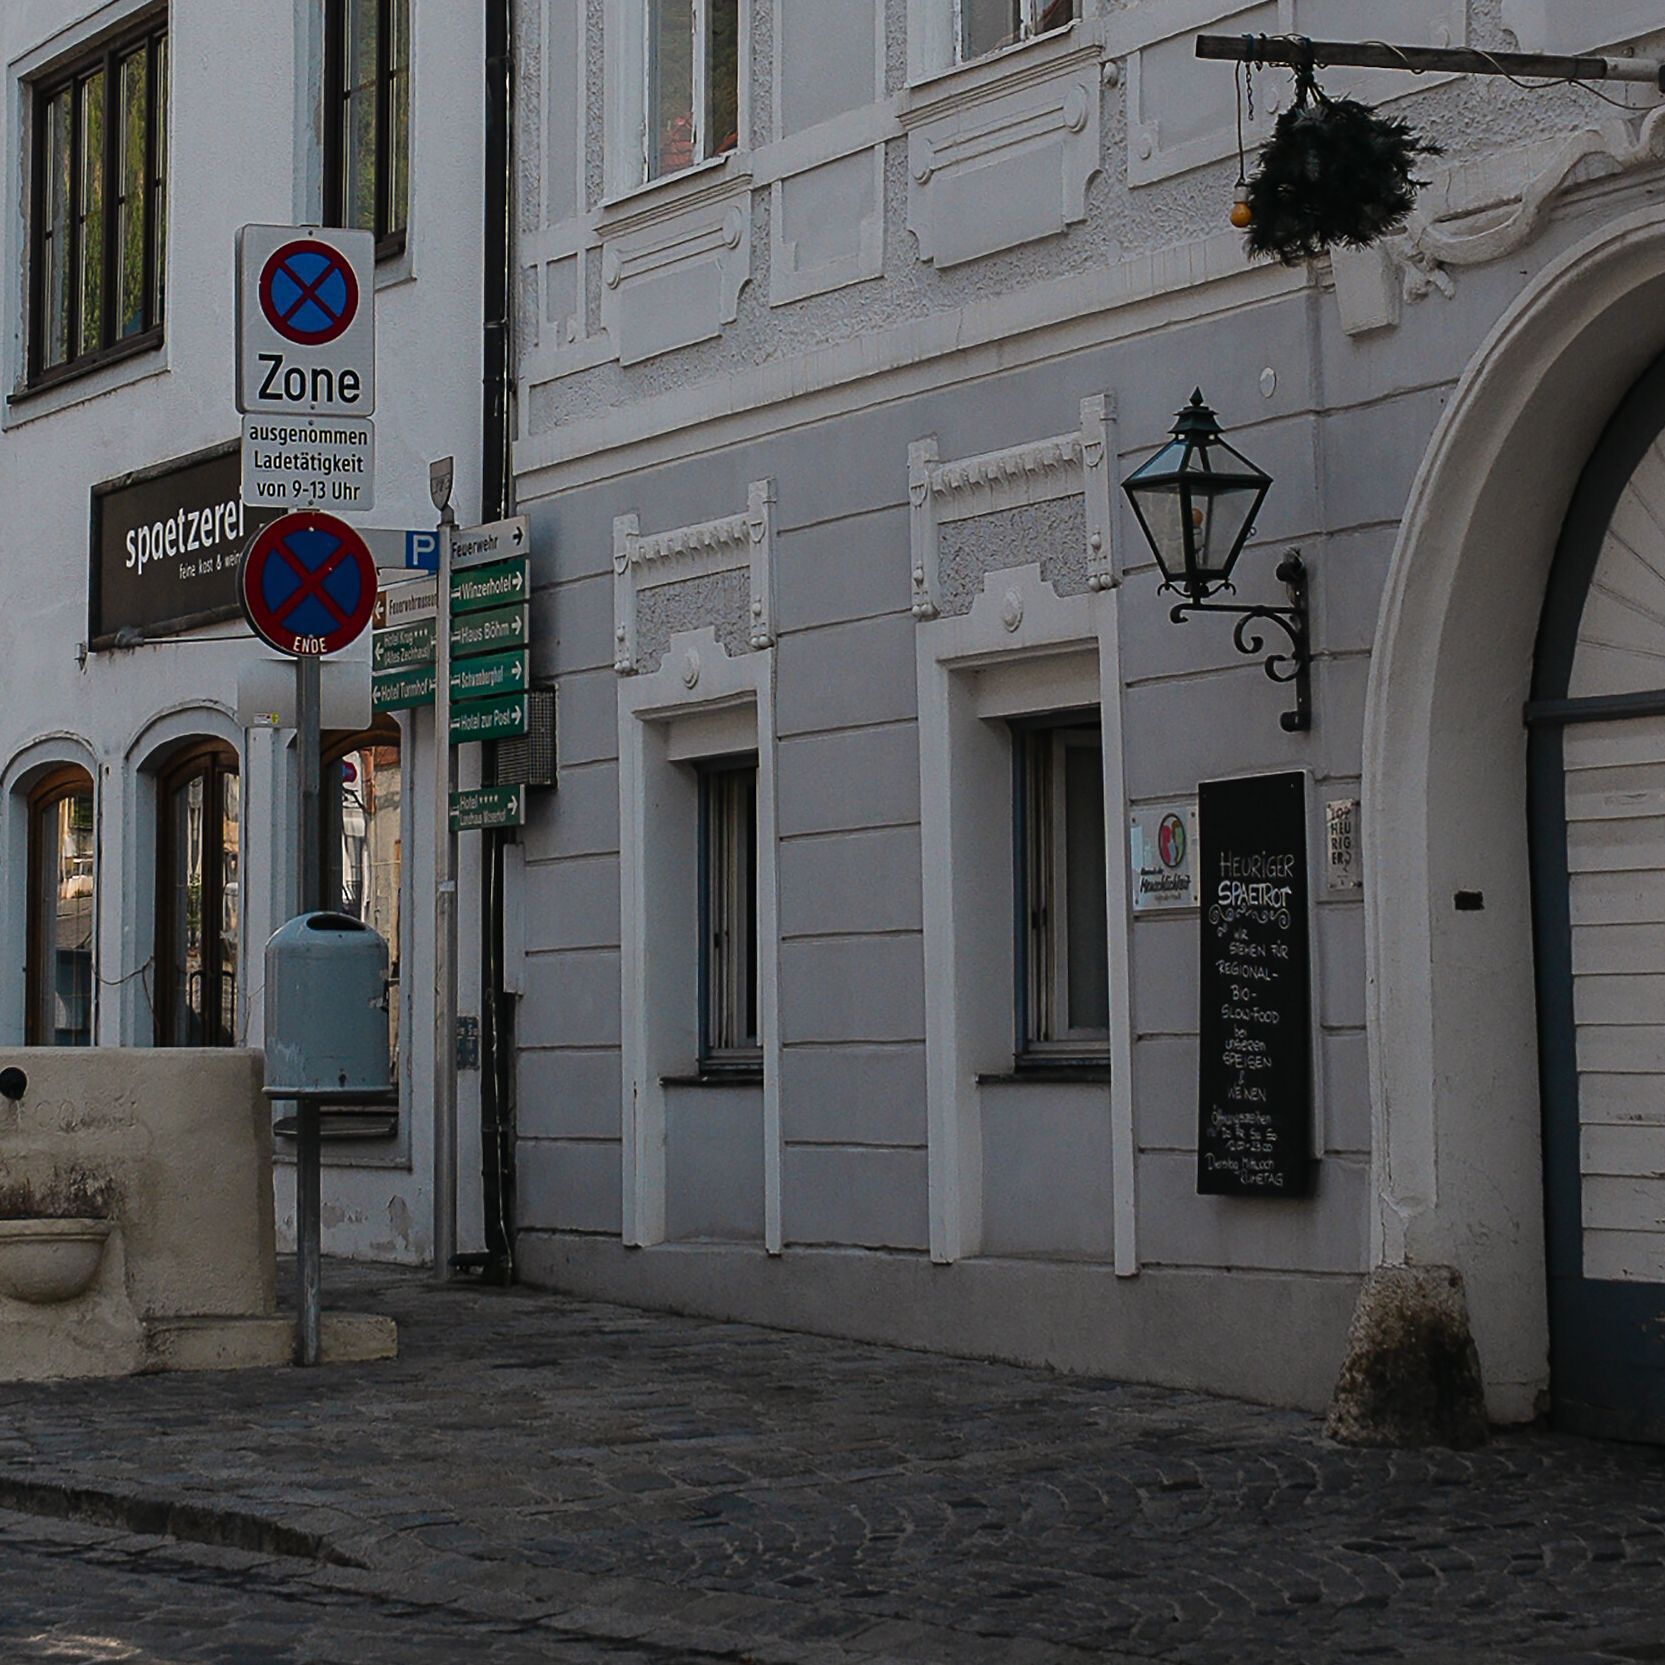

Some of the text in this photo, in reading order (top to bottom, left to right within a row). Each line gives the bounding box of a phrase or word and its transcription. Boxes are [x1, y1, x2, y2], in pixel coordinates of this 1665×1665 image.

[258, 352, 361, 404] Zone
[249, 426, 368, 446] ausgenommen
[254, 450, 364, 476] Ladetätigkeit
[256, 479, 362, 501] von 9-13 Uhr
[125, 486, 244, 576] spaetzerei
[412, 534, 436, 567] P
[450, 533, 499, 560] Feuerwehr
[461, 573, 512, 600] Winzerhotel
[293, 636, 327, 653] ENDE
[461, 620, 510, 645] Haus Böhm
[381, 682, 399, 702] Hotel
[460, 708, 511, 730] Hotel zur Post
[460, 794, 478, 811] Hotel
[1218, 880, 1292, 908] SPAETROT
[1222, 1051, 1272, 1070] SPEISEN
